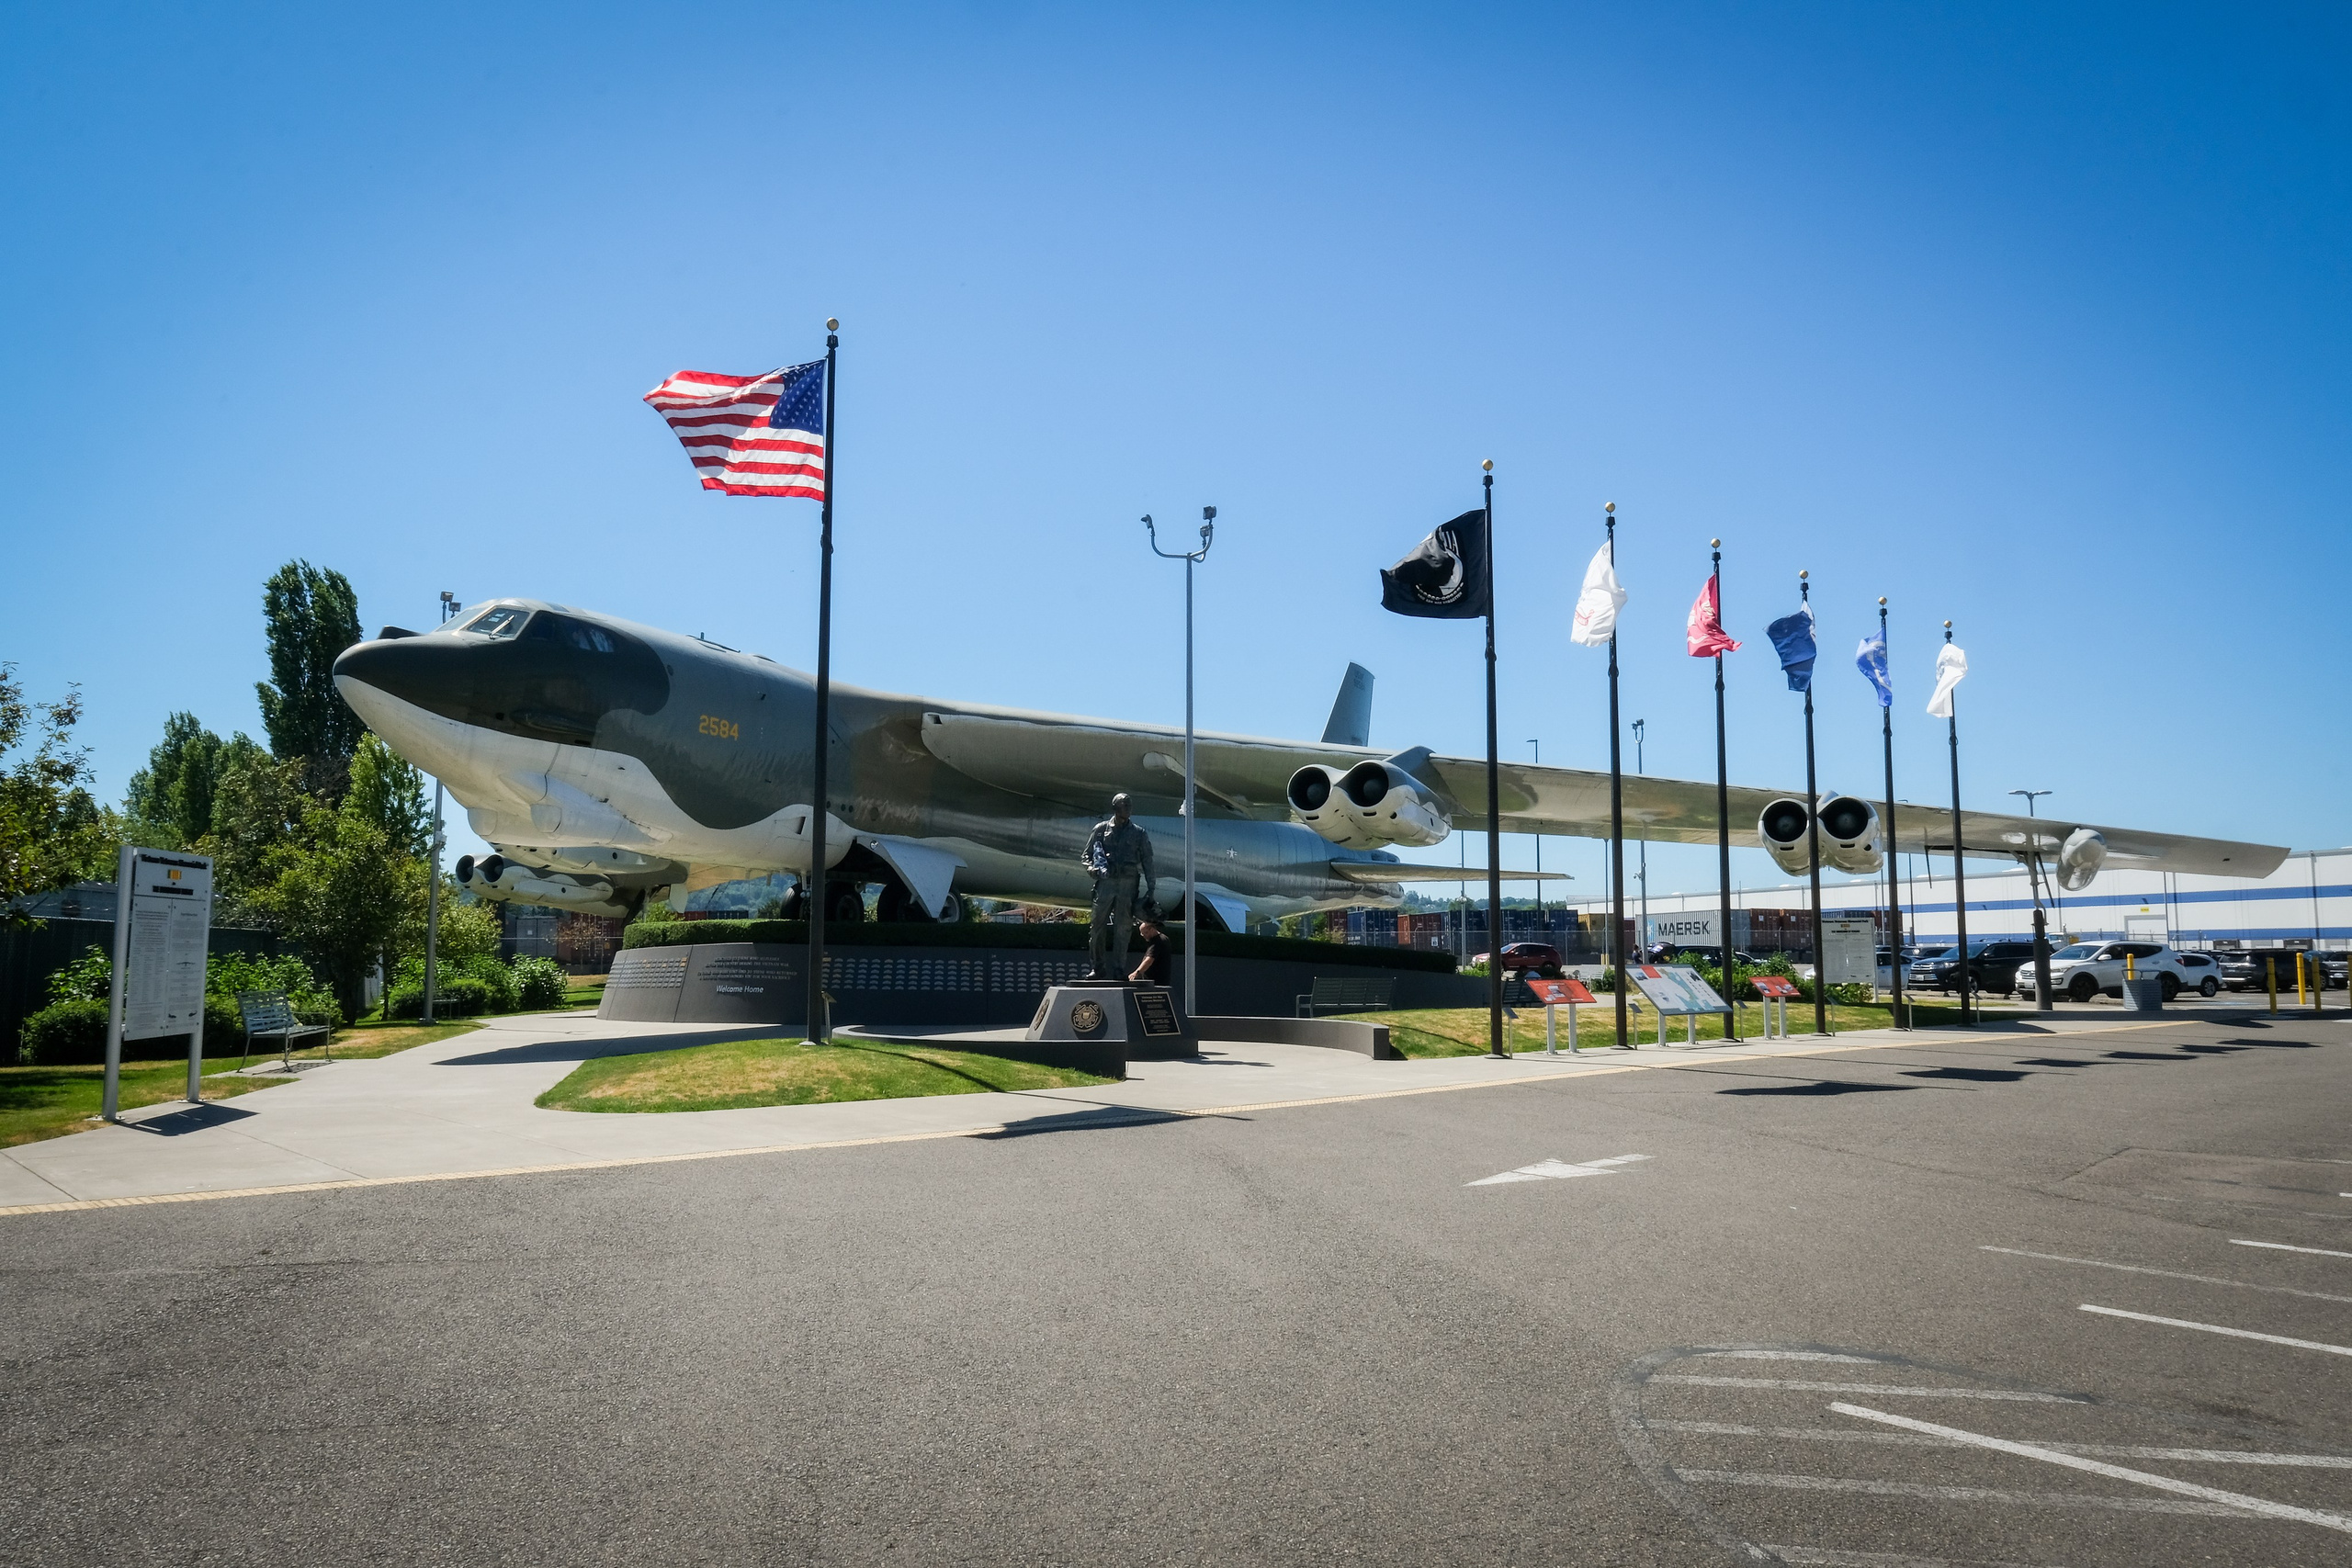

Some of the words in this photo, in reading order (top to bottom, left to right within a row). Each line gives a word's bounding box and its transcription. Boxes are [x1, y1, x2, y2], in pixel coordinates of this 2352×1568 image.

[699, 715, 739, 741] 2584
[1657, 920, 1711, 937] MAERSK
[717, 985, 743, 993] Welcome
